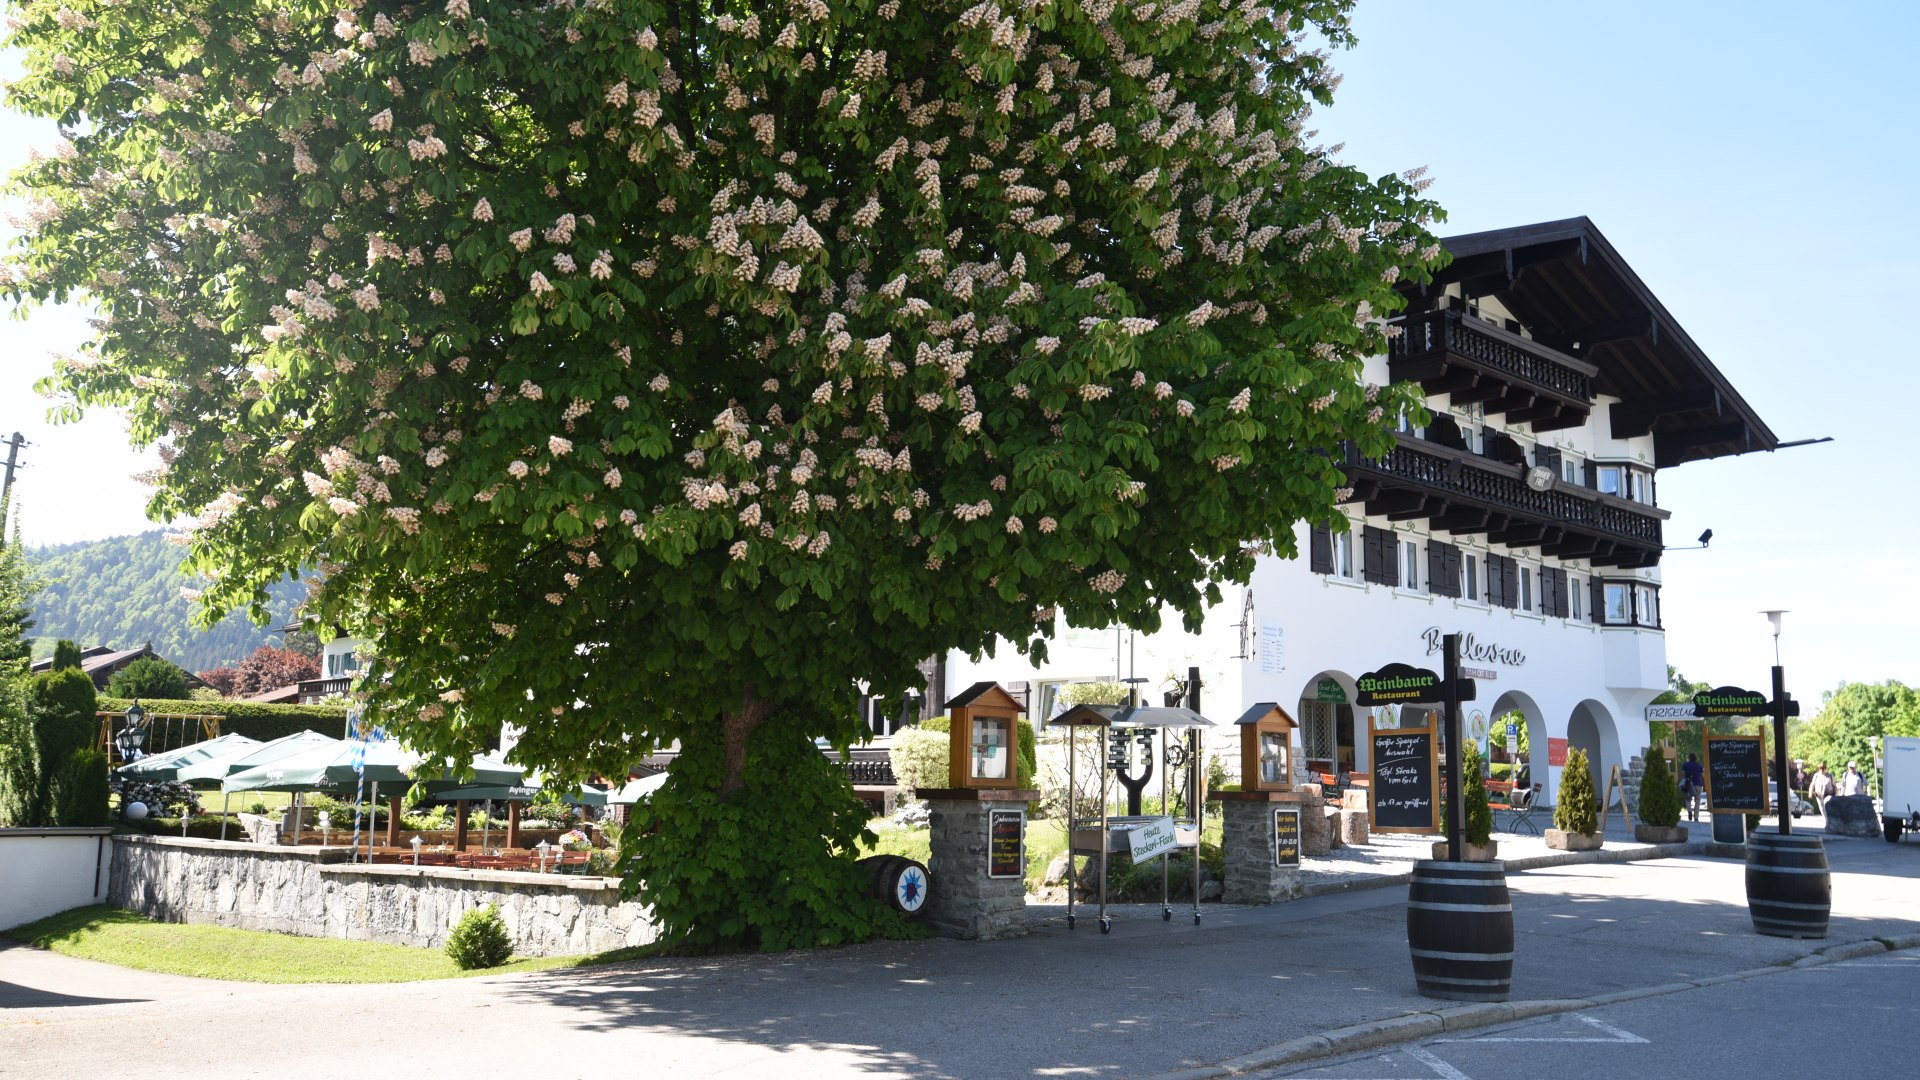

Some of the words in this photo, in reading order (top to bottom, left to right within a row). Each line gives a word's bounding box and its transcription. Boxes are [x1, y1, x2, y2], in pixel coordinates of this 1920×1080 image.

[1421, 625, 1526, 666] Bllevue
[1471, 670, 1494, 679] HOTEL
[1360, 675, 1433, 692] Weinbauer
[1372, 690, 1420, 700] Restaurant
[1697, 694, 1763, 706] Weinbauer
[1507, 725, 1514, 735] P
[1384, 747, 1414, 757] Auswahl
[1395, 766, 1417, 775] Steaks
[1401, 775, 1419, 784] Grill
[508, 786, 538, 796] Ayinger
[1143, 826, 1161, 840] Heute
